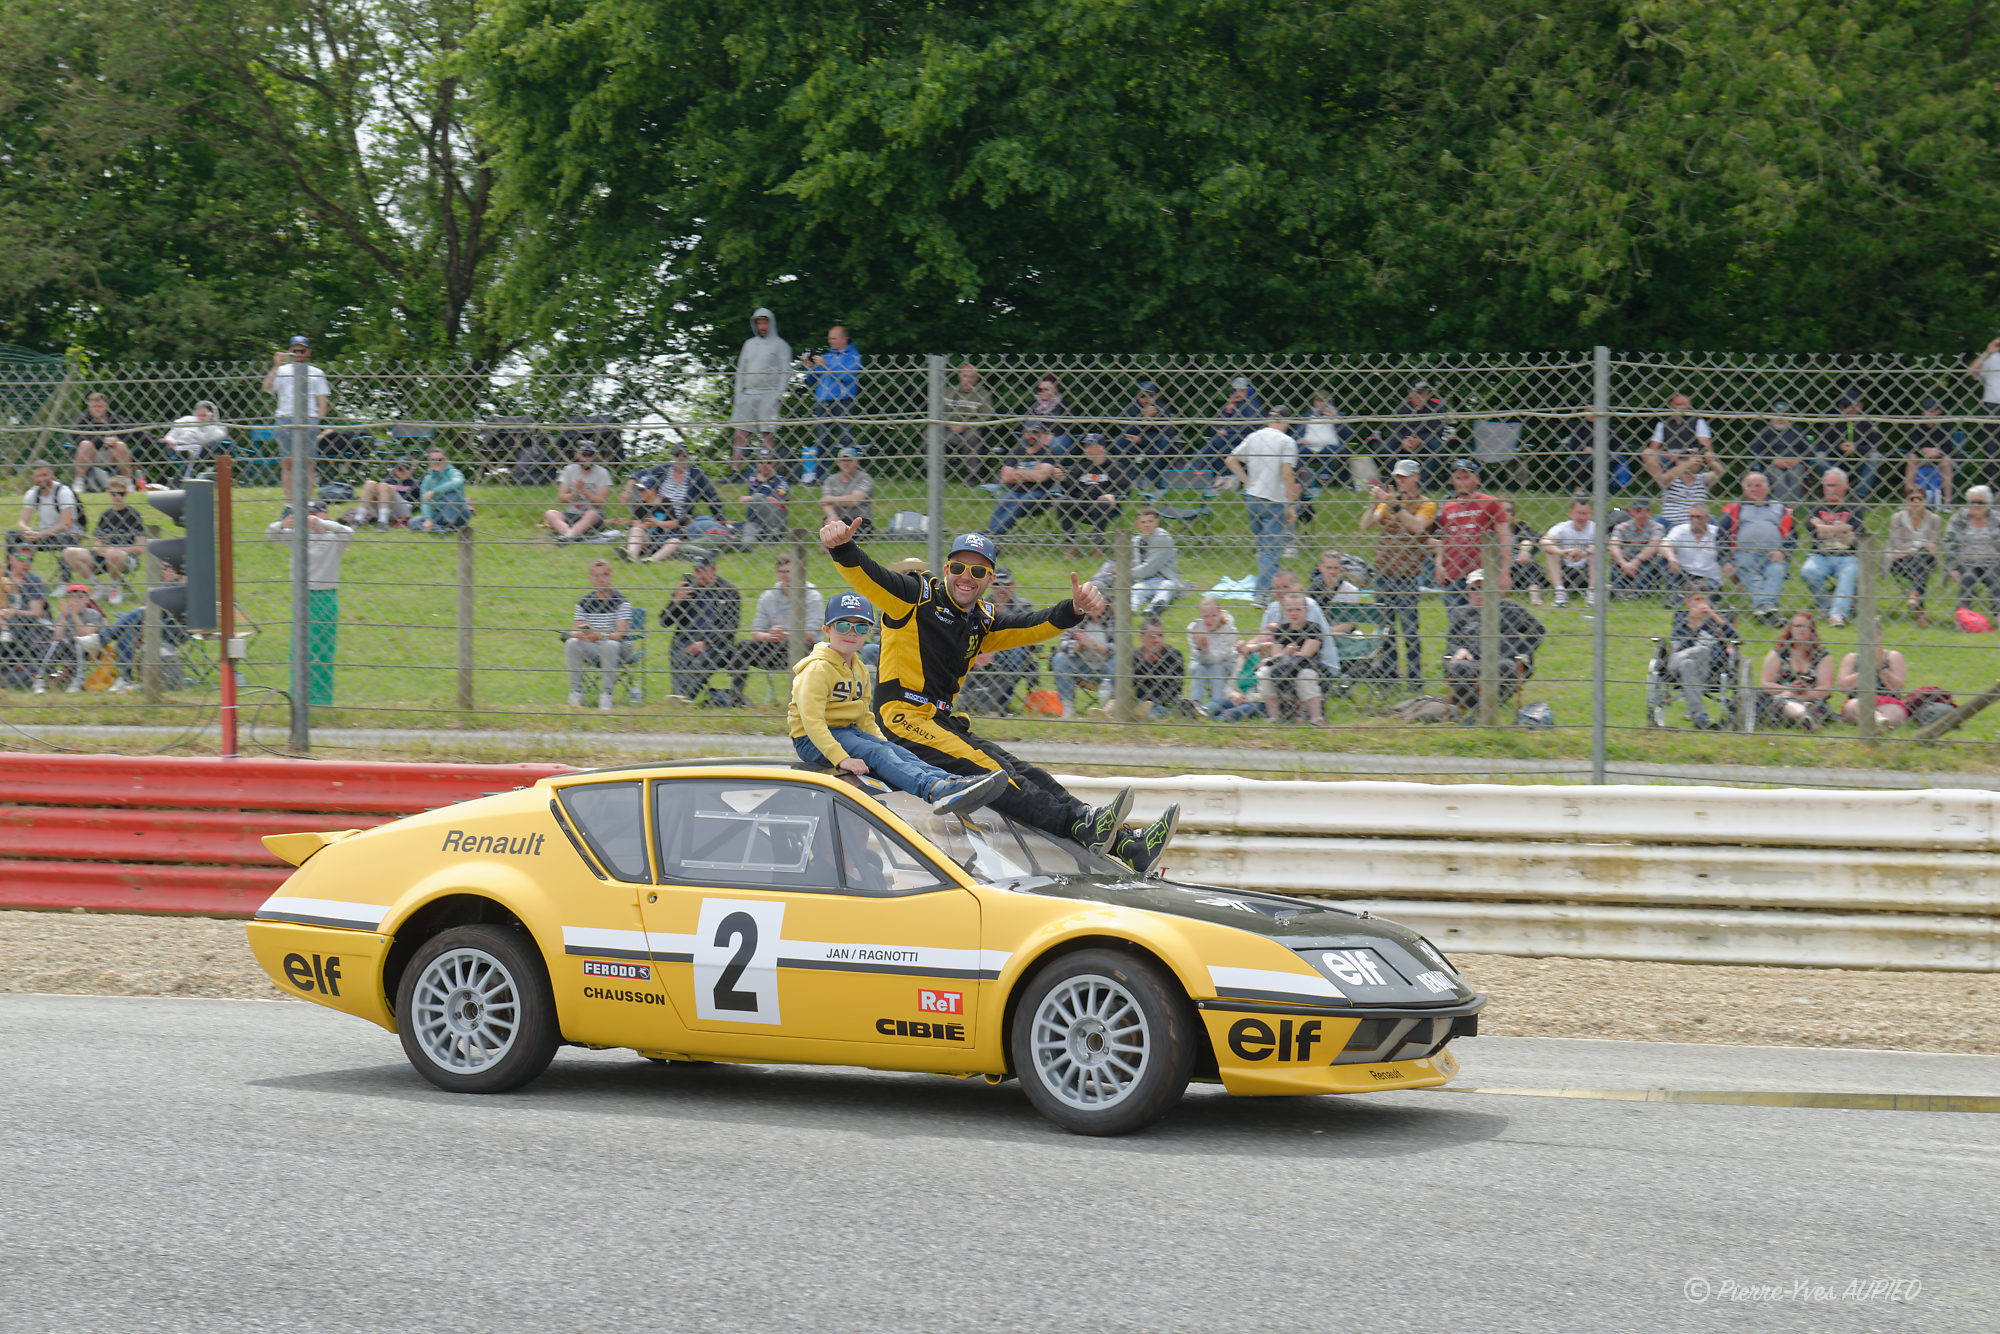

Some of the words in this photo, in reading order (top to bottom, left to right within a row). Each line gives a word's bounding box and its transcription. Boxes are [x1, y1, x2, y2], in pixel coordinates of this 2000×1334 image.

[901, 720, 936, 740] REAULT
[441, 830, 545, 856] Renault
[713, 911, 759, 1013] 2
[826, 948, 850, 959] JAN
[859, 949, 919, 962] RAGNOTTI
[283, 952, 342, 997] elf
[585, 962, 636, 978] FERODO
[1321, 949, 1388, 986] elf
[583, 986, 666, 1006] CHAUSSON
[1227, 1017, 1322, 1062] elf
[1369, 1068, 1405, 1081] Renault
